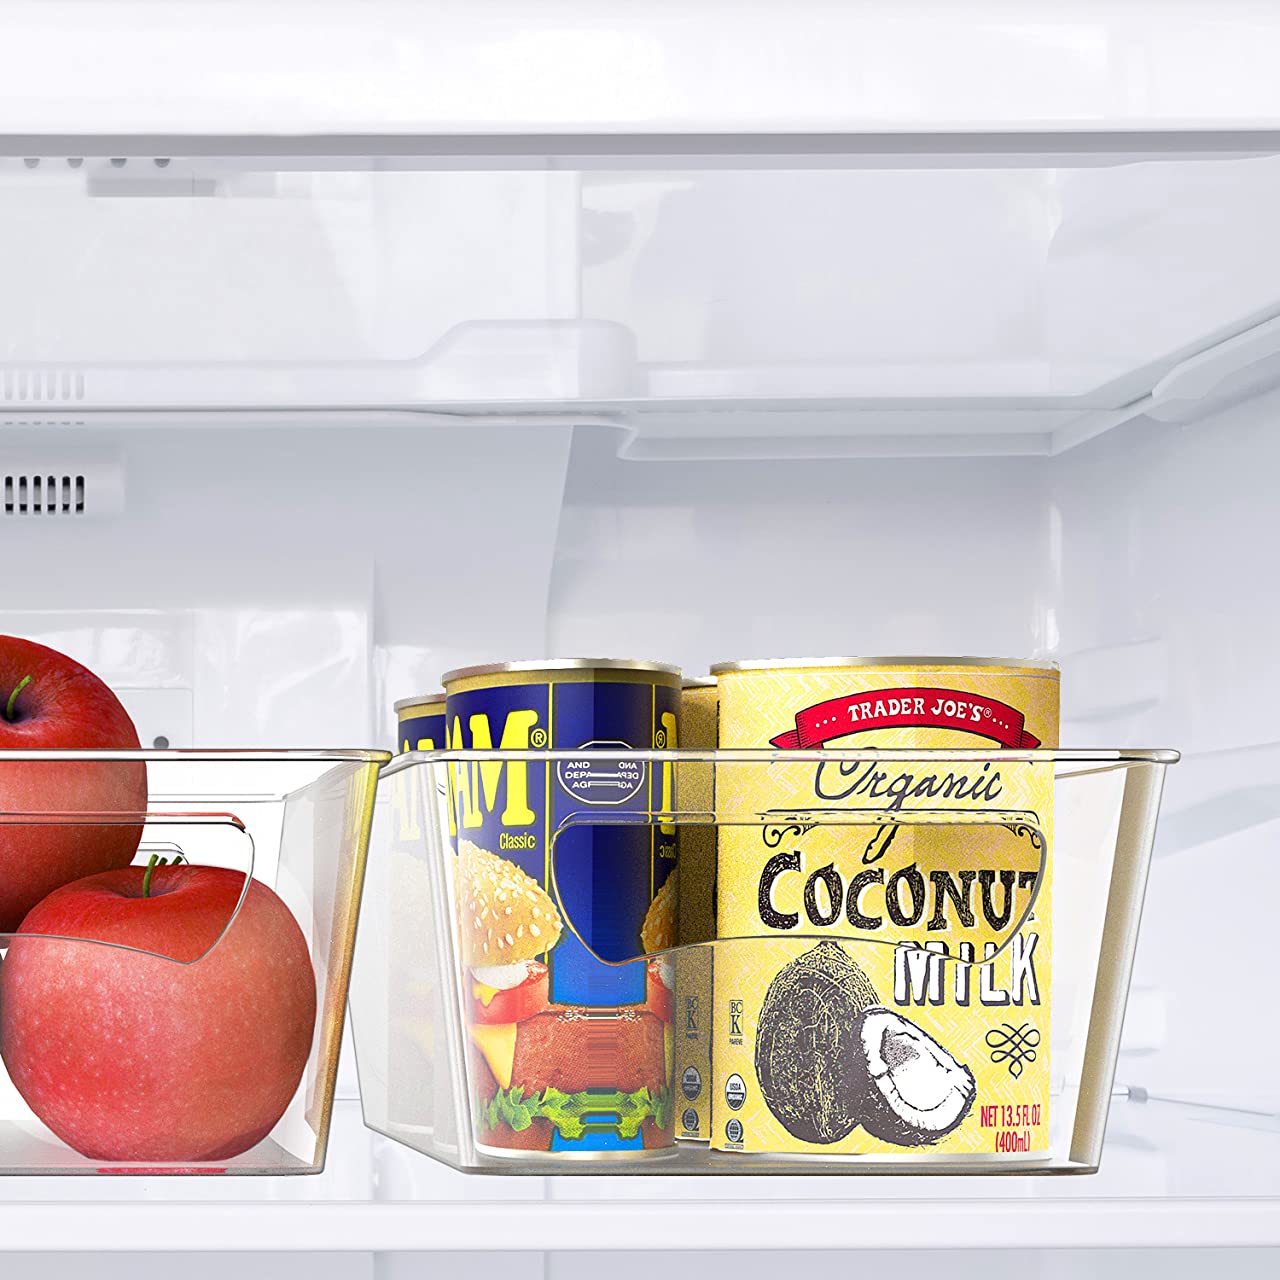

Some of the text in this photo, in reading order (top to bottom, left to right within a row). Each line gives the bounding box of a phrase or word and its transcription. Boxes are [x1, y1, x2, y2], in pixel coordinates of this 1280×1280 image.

[847, 697, 925, 722] TRADER
[499, 831, 536, 850] Classic
[894, 932, 1041, 1007] MILK
[980, 1103, 1041, 1127] NET 13.5 FL OZ
[995, 1130, 1031, 1153] (400mL)
